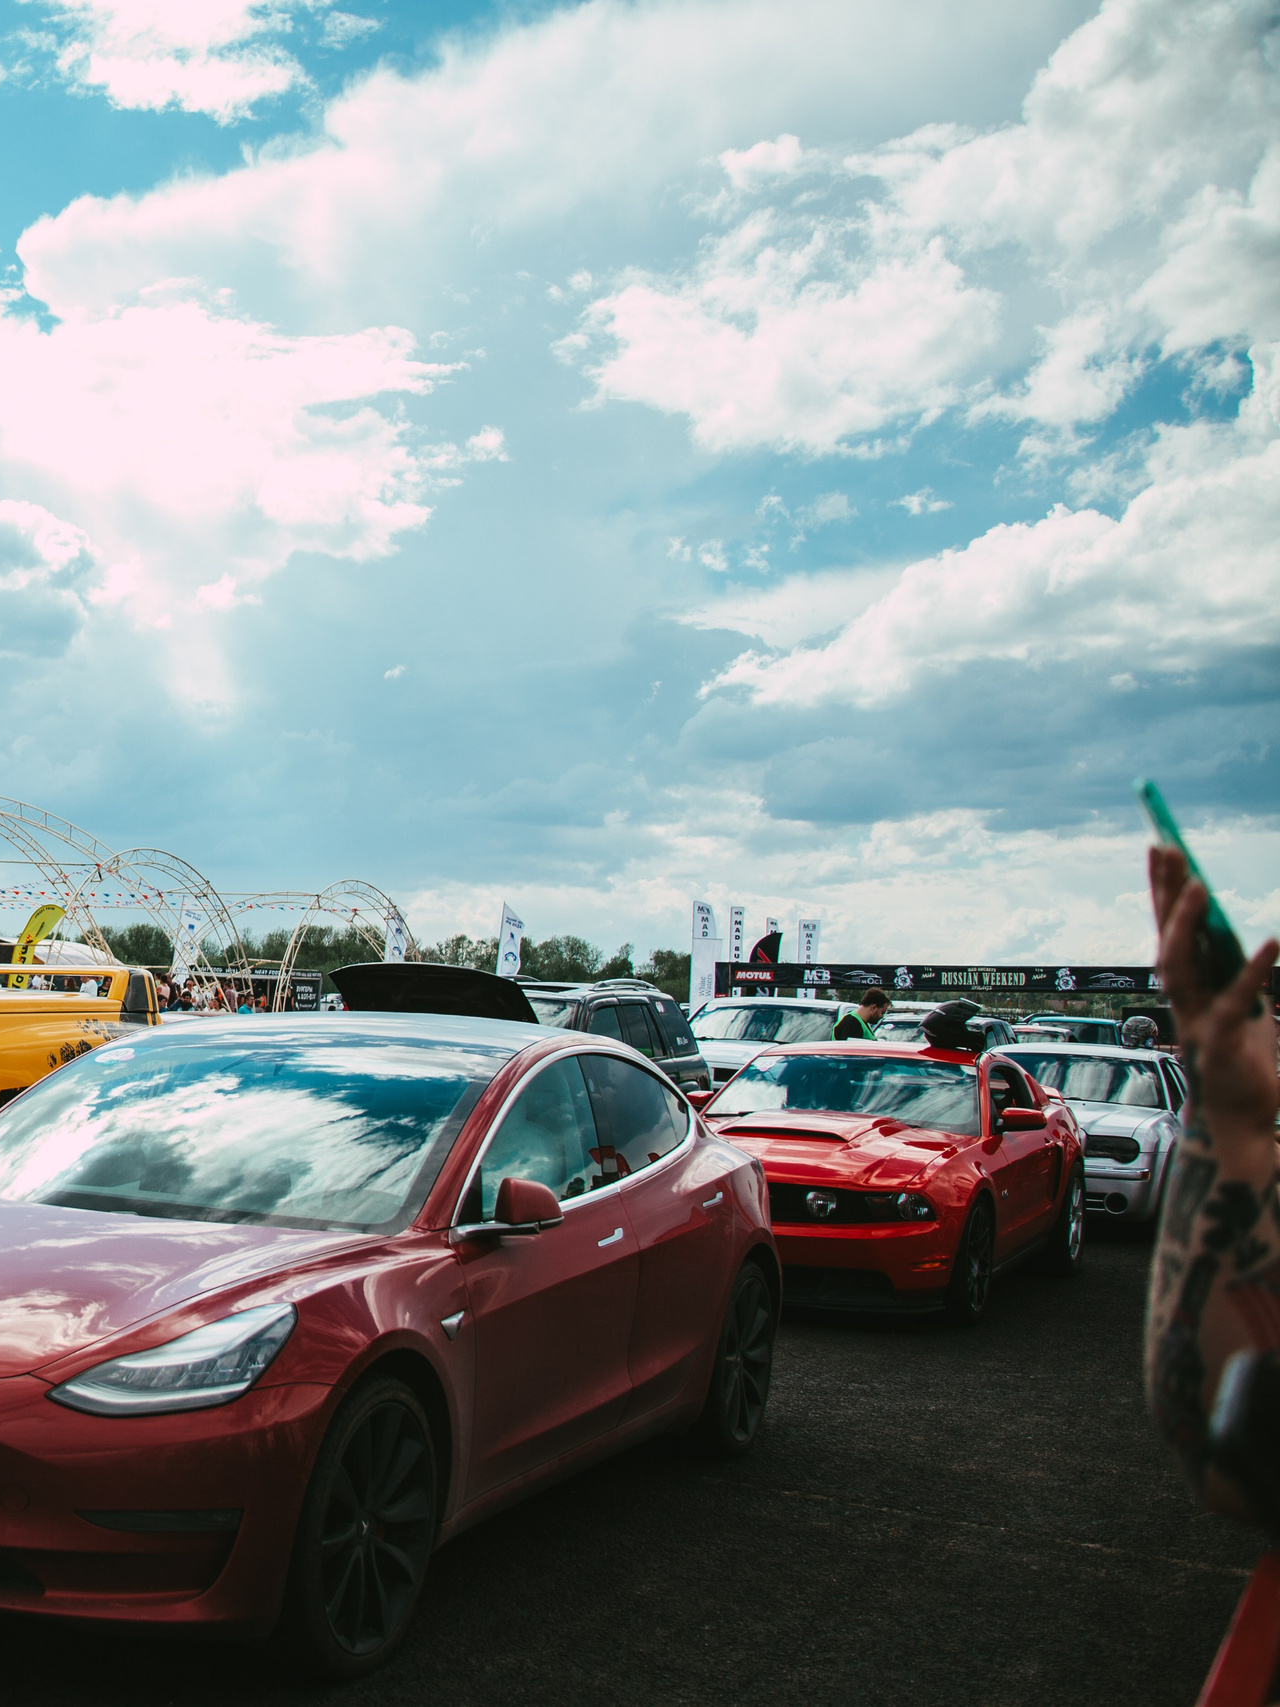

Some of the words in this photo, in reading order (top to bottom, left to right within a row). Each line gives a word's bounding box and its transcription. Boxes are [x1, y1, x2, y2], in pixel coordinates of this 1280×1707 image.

[701, 916, 709, 937] MAD
[734, 920, 742, 940] MAD
[805, 933, 813, 951] MAD
[736, 971, 771, 980] MOTUL
[940, 971, 979, 986] RUSSIAN
[981, 972, 1026, 986] WEEKEND
